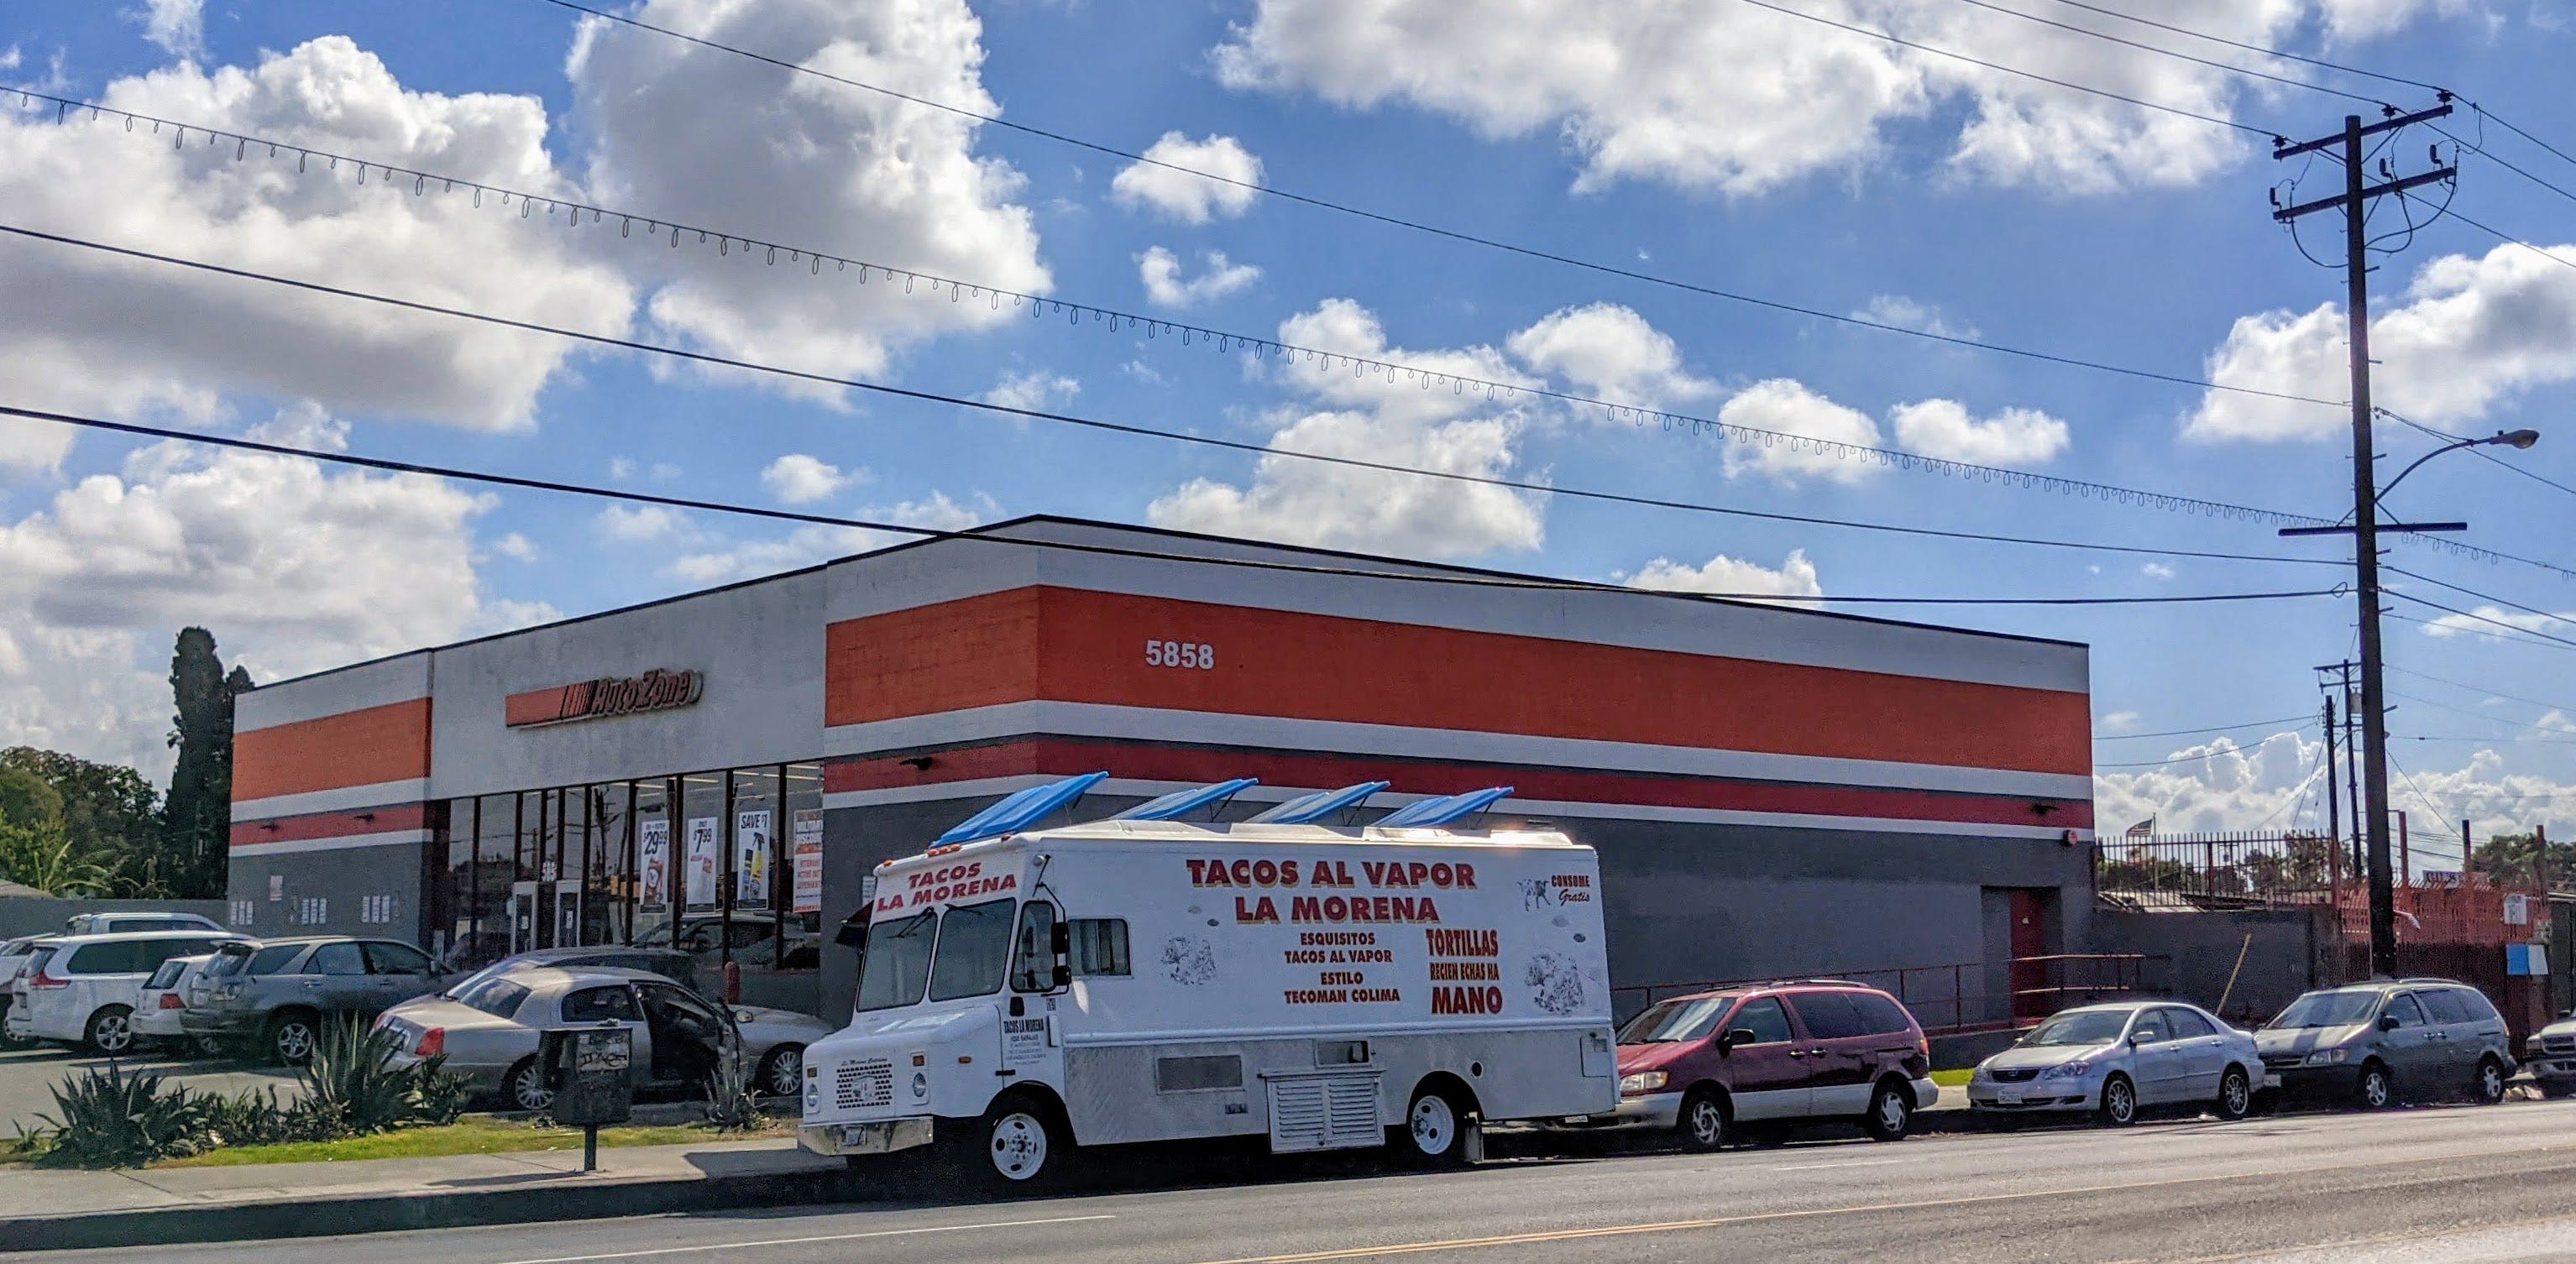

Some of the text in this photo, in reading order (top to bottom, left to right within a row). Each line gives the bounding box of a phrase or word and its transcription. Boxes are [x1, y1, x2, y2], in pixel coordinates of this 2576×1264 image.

[1145, 640, 1214, 670] 5858
[591, 669, 691, 715] AutoZone
[741, 814, 767, 829] SAVE $1
[908, 862, 982, 889] TACOS
[1186, 859, 1478, 890] TACOS AL VAPOR
[1551, 875, 1590, 887] CONSOME
[877, 874, 1017, 911] LA MORENA
[1558, 889, 1590, 906] Gratis
[1235, 896, 1440, 924] LA MORENA
[1300, 932, 1375, 945] ESQUISITOS
[1426, 928, 1499, 957] TORTILLAS
[1284, 949, 1392, 964] TACOS AL VAPOR
[1320, 972, 1364, 985] ESTILO
[1429, 963, 1500, 980] RECIEN ECHAS HA
[1284, 989, 1401, 1004] TECOMAN COLIMA
[1432, 986, 1503, 1015] MANO
